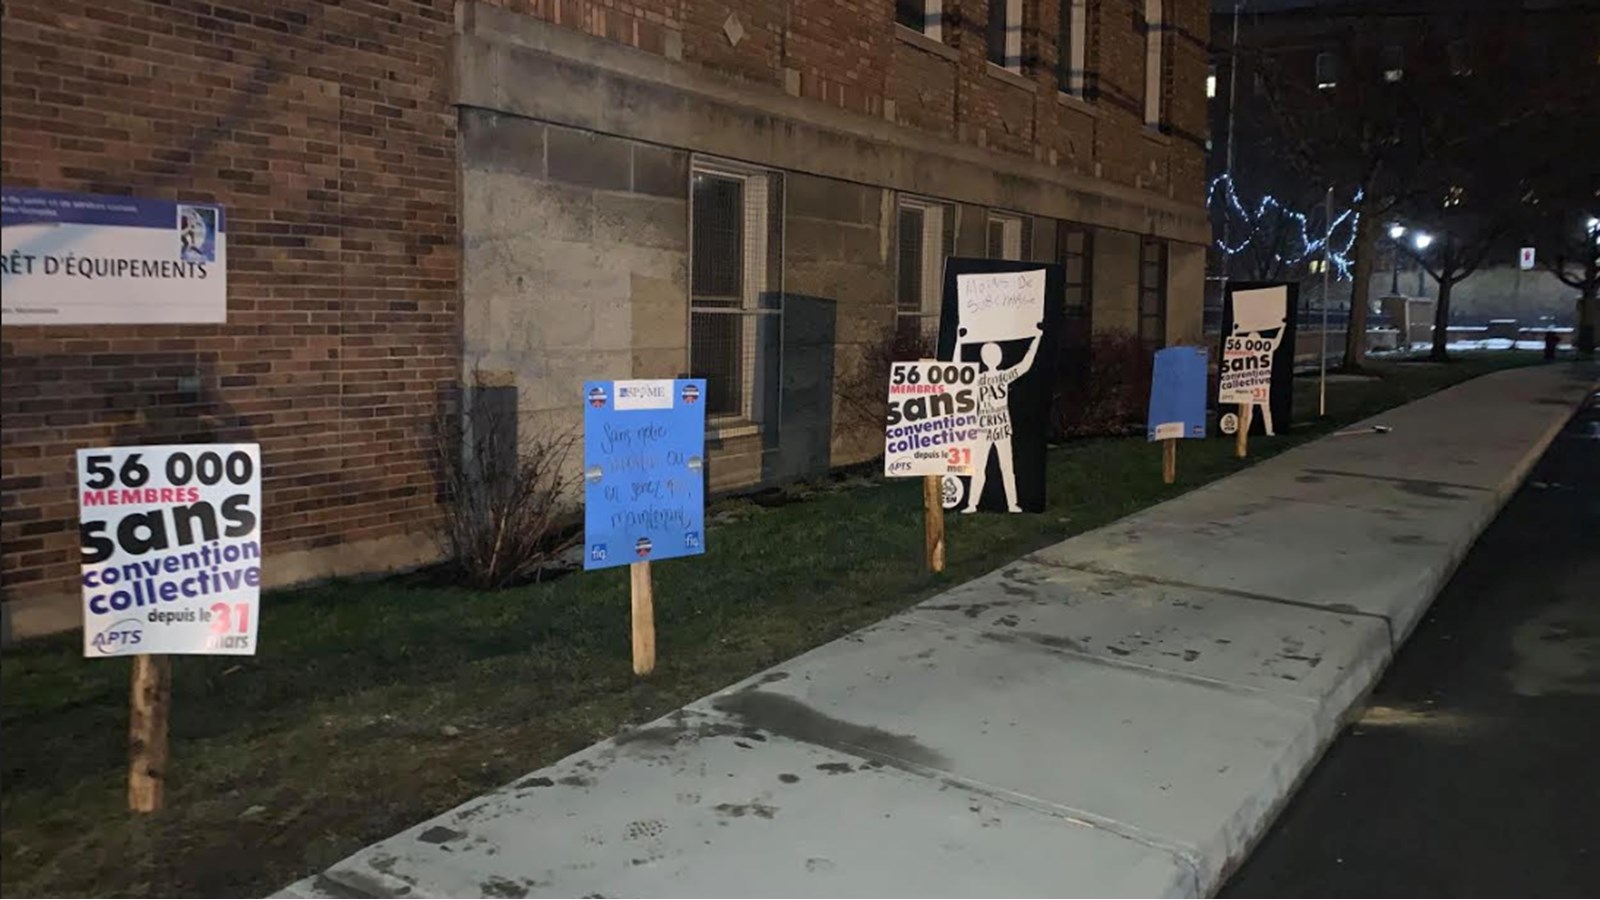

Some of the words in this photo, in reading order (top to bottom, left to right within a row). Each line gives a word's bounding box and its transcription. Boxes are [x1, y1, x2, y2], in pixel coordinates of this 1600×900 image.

[44, 252, 208, 280] D'ÉQUIPEMENTS
[1226, 339, 1241, 350] 56
[1245, 339, 1272, 352] 000
[1220, 354, 1271, 373] sans
[892, 365, 921, 385] 56
[927, 365, 975, 385] 000
[1220, 369, 1271, 381] convention
[1221, 377, 1272, 390] collective
[890, 384, 945, 394] MEMBRES
[979, 383, 1006, 402] PAS
[1253, 388, 1267, 399] 31
[886, 388, 975, 426] sans
[886, 415, 977, 439] convention
[986, 425, 1013, 442] AGIR
[887, 428, 978, 454] collective
[913, 450, 940, 460] depuis
[941, 449, 949, 459] le
[947, 447, 971, 465] 31
[85, 453, 150, 489] 56
[165, 451, 254, 487] 000
[888, 461, 912, 472] APTS
[83, 487, 200, 506] MEMBRES
[80, 493, 257, 565] sans
[82, 540, 260, 588] convention
[89, 566, 261, 615] collective
[147, 607, 196, 626] depuis
[199, 606, 212, 622] le
[209, 601, 250, 635] 31
[91, 630, 143, 647] APTS
